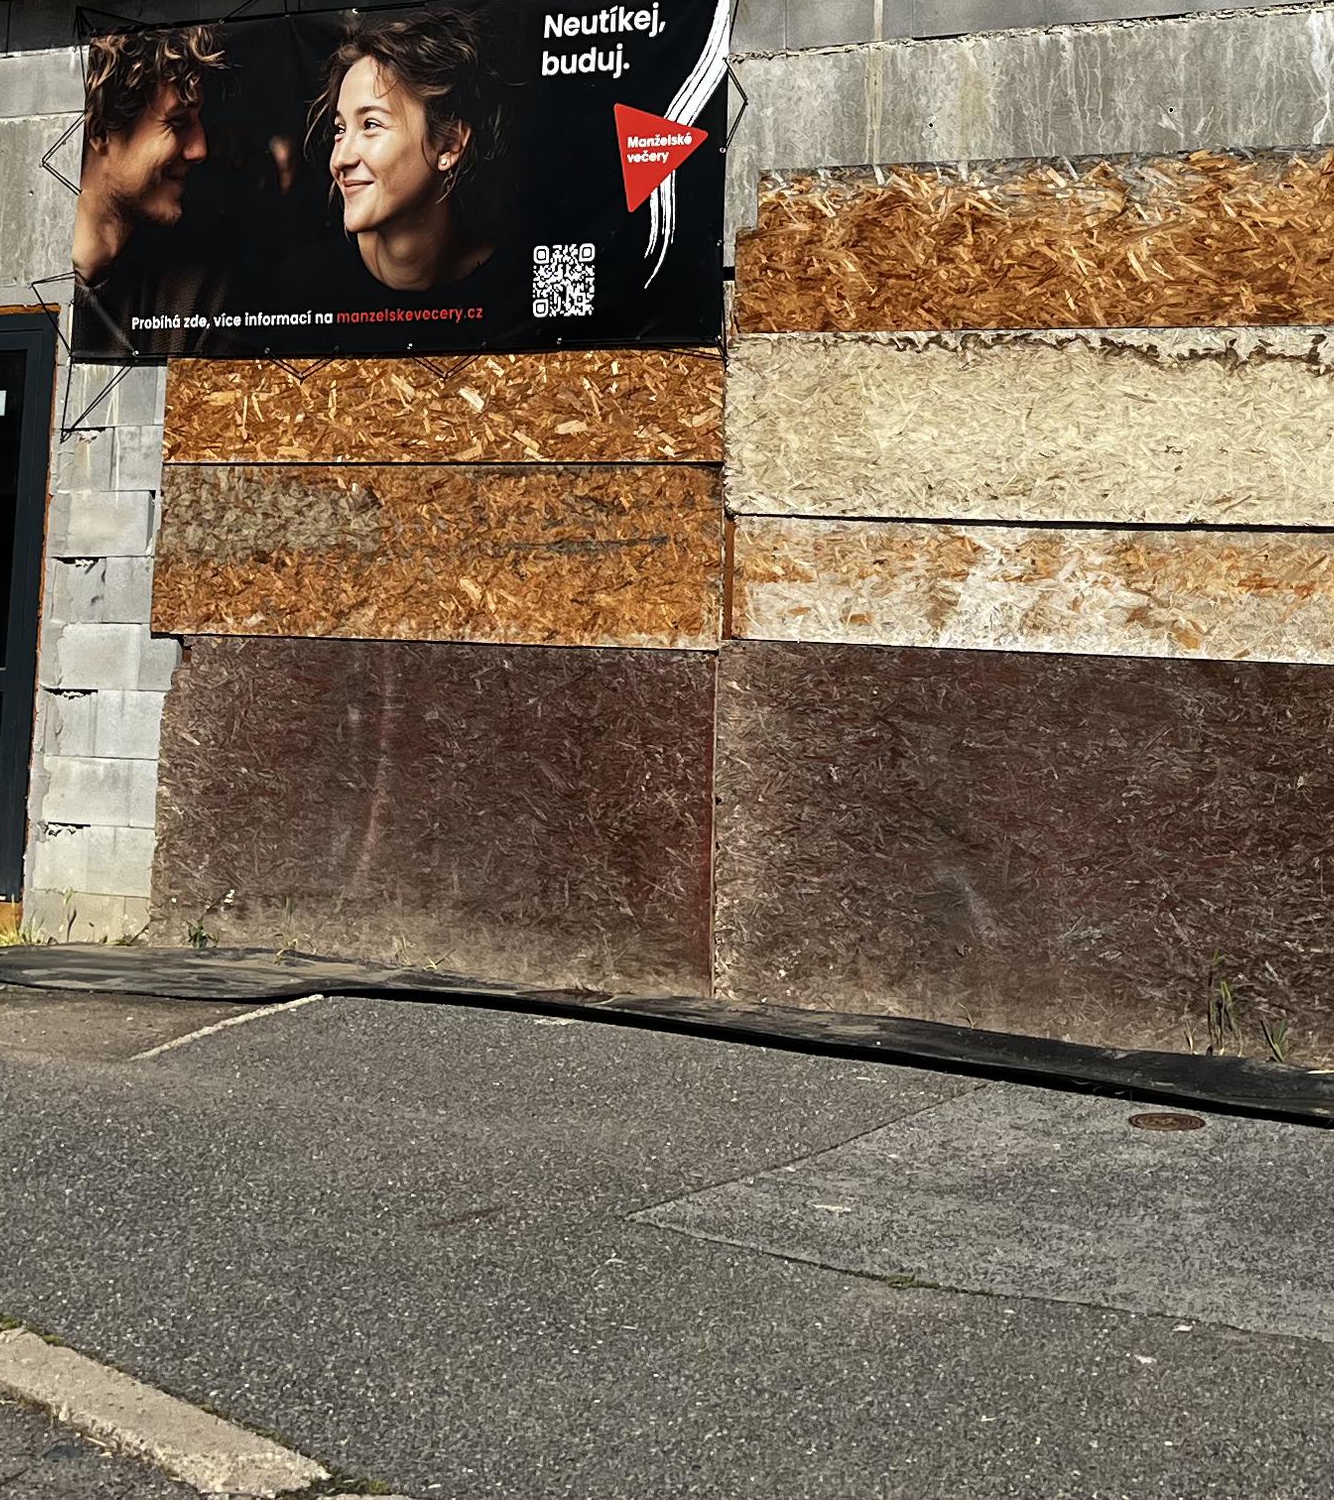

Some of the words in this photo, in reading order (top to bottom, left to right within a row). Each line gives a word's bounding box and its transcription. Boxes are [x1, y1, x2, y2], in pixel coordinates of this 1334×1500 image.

[544, 2, 666, 38] Neutíkej,
[541, 43, 630, 79] buduj.
[627, 132, 693, 148] Manželské
[627, 150, 670, 164] večery
[131, 314, 181, 330] Probíhá
[183, 314, 211, 329] zde,
[213, 312, 242, 327] více
[244, 310, 312, 326] informací
[315, 312, 333, 324] na
[336, 307, 484, 324] manzelskevecery.cz
